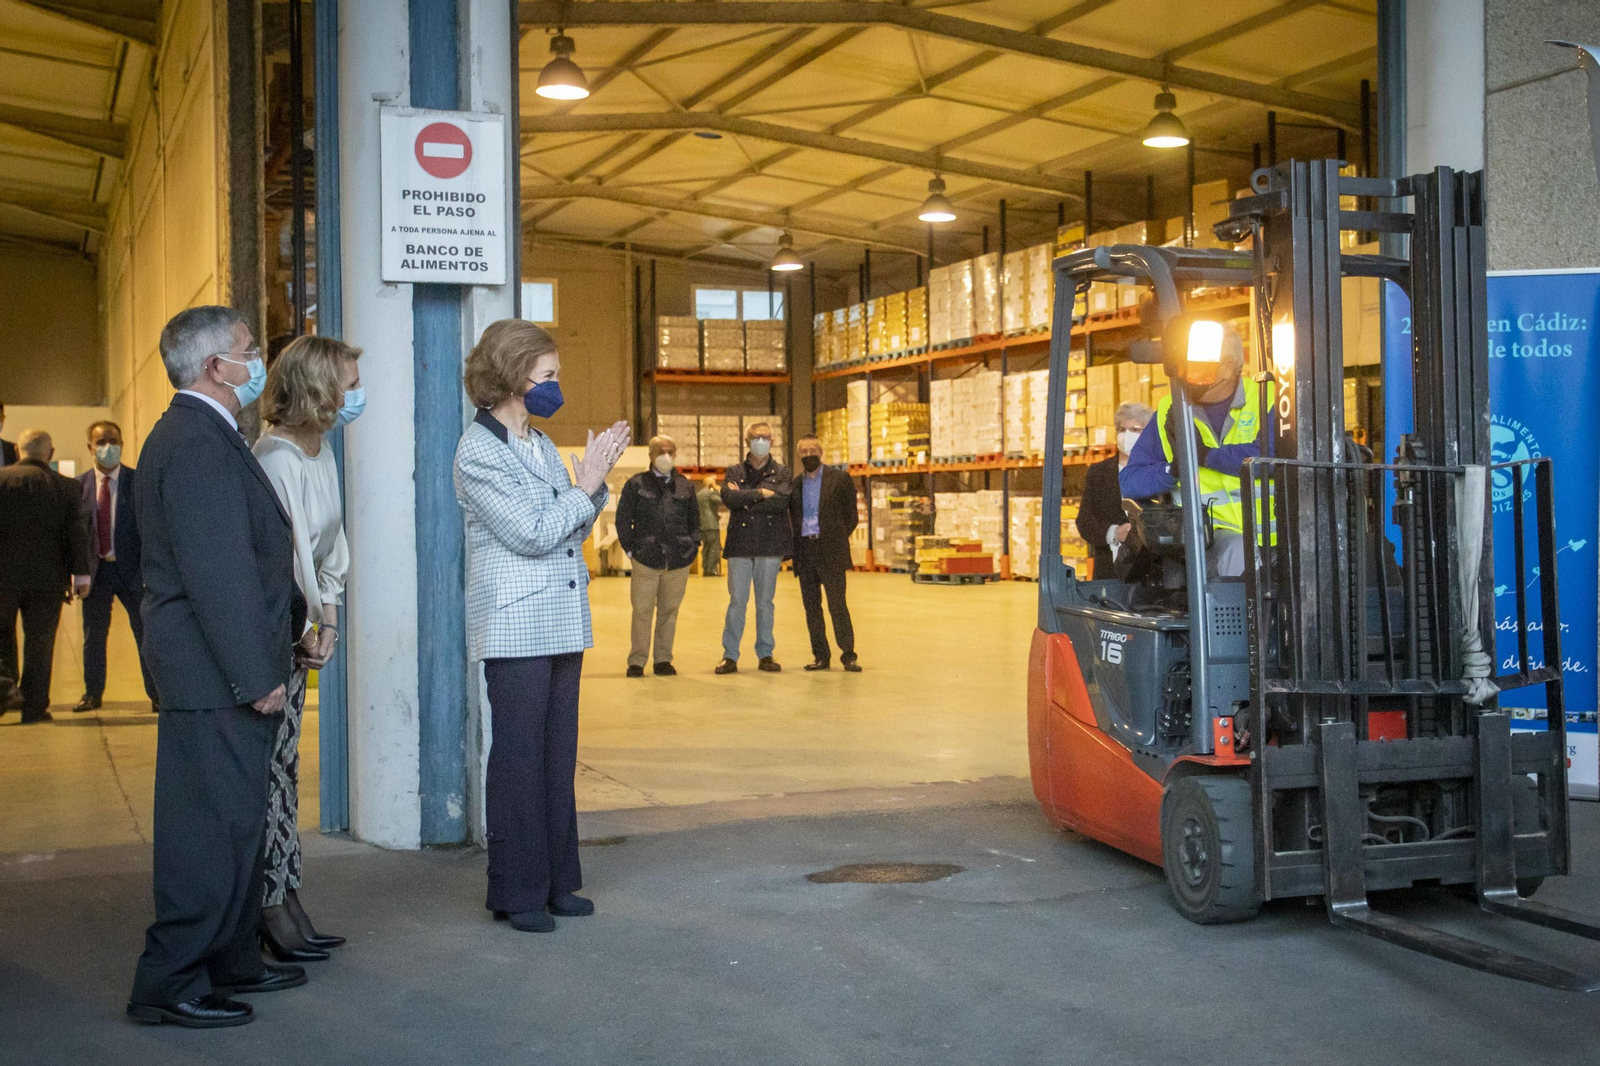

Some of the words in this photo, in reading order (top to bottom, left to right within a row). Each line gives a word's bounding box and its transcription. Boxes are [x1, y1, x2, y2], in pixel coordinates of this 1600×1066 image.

[402, 189, 486, 204] PROHIBIDO
[413, 205, 431, 216] EL
[436, 206, 476, 218] PASO
[399, 226, 419, 234] TODA
[421, 227, 458, 235] PERSONA
[406, 244, 459, 256] BANCO
[464, 246, 483, 258] DE
[400, 258, 489, 272] ALIMENTOS
[1401, 316, 1411, 335] 2
[1487, 319, 1511, 332] en
[1517, 311, 1587, 332] Cádiz:
[1512, 338, 1572, 358] todos
[1101, 641, 1122, 665] 16
